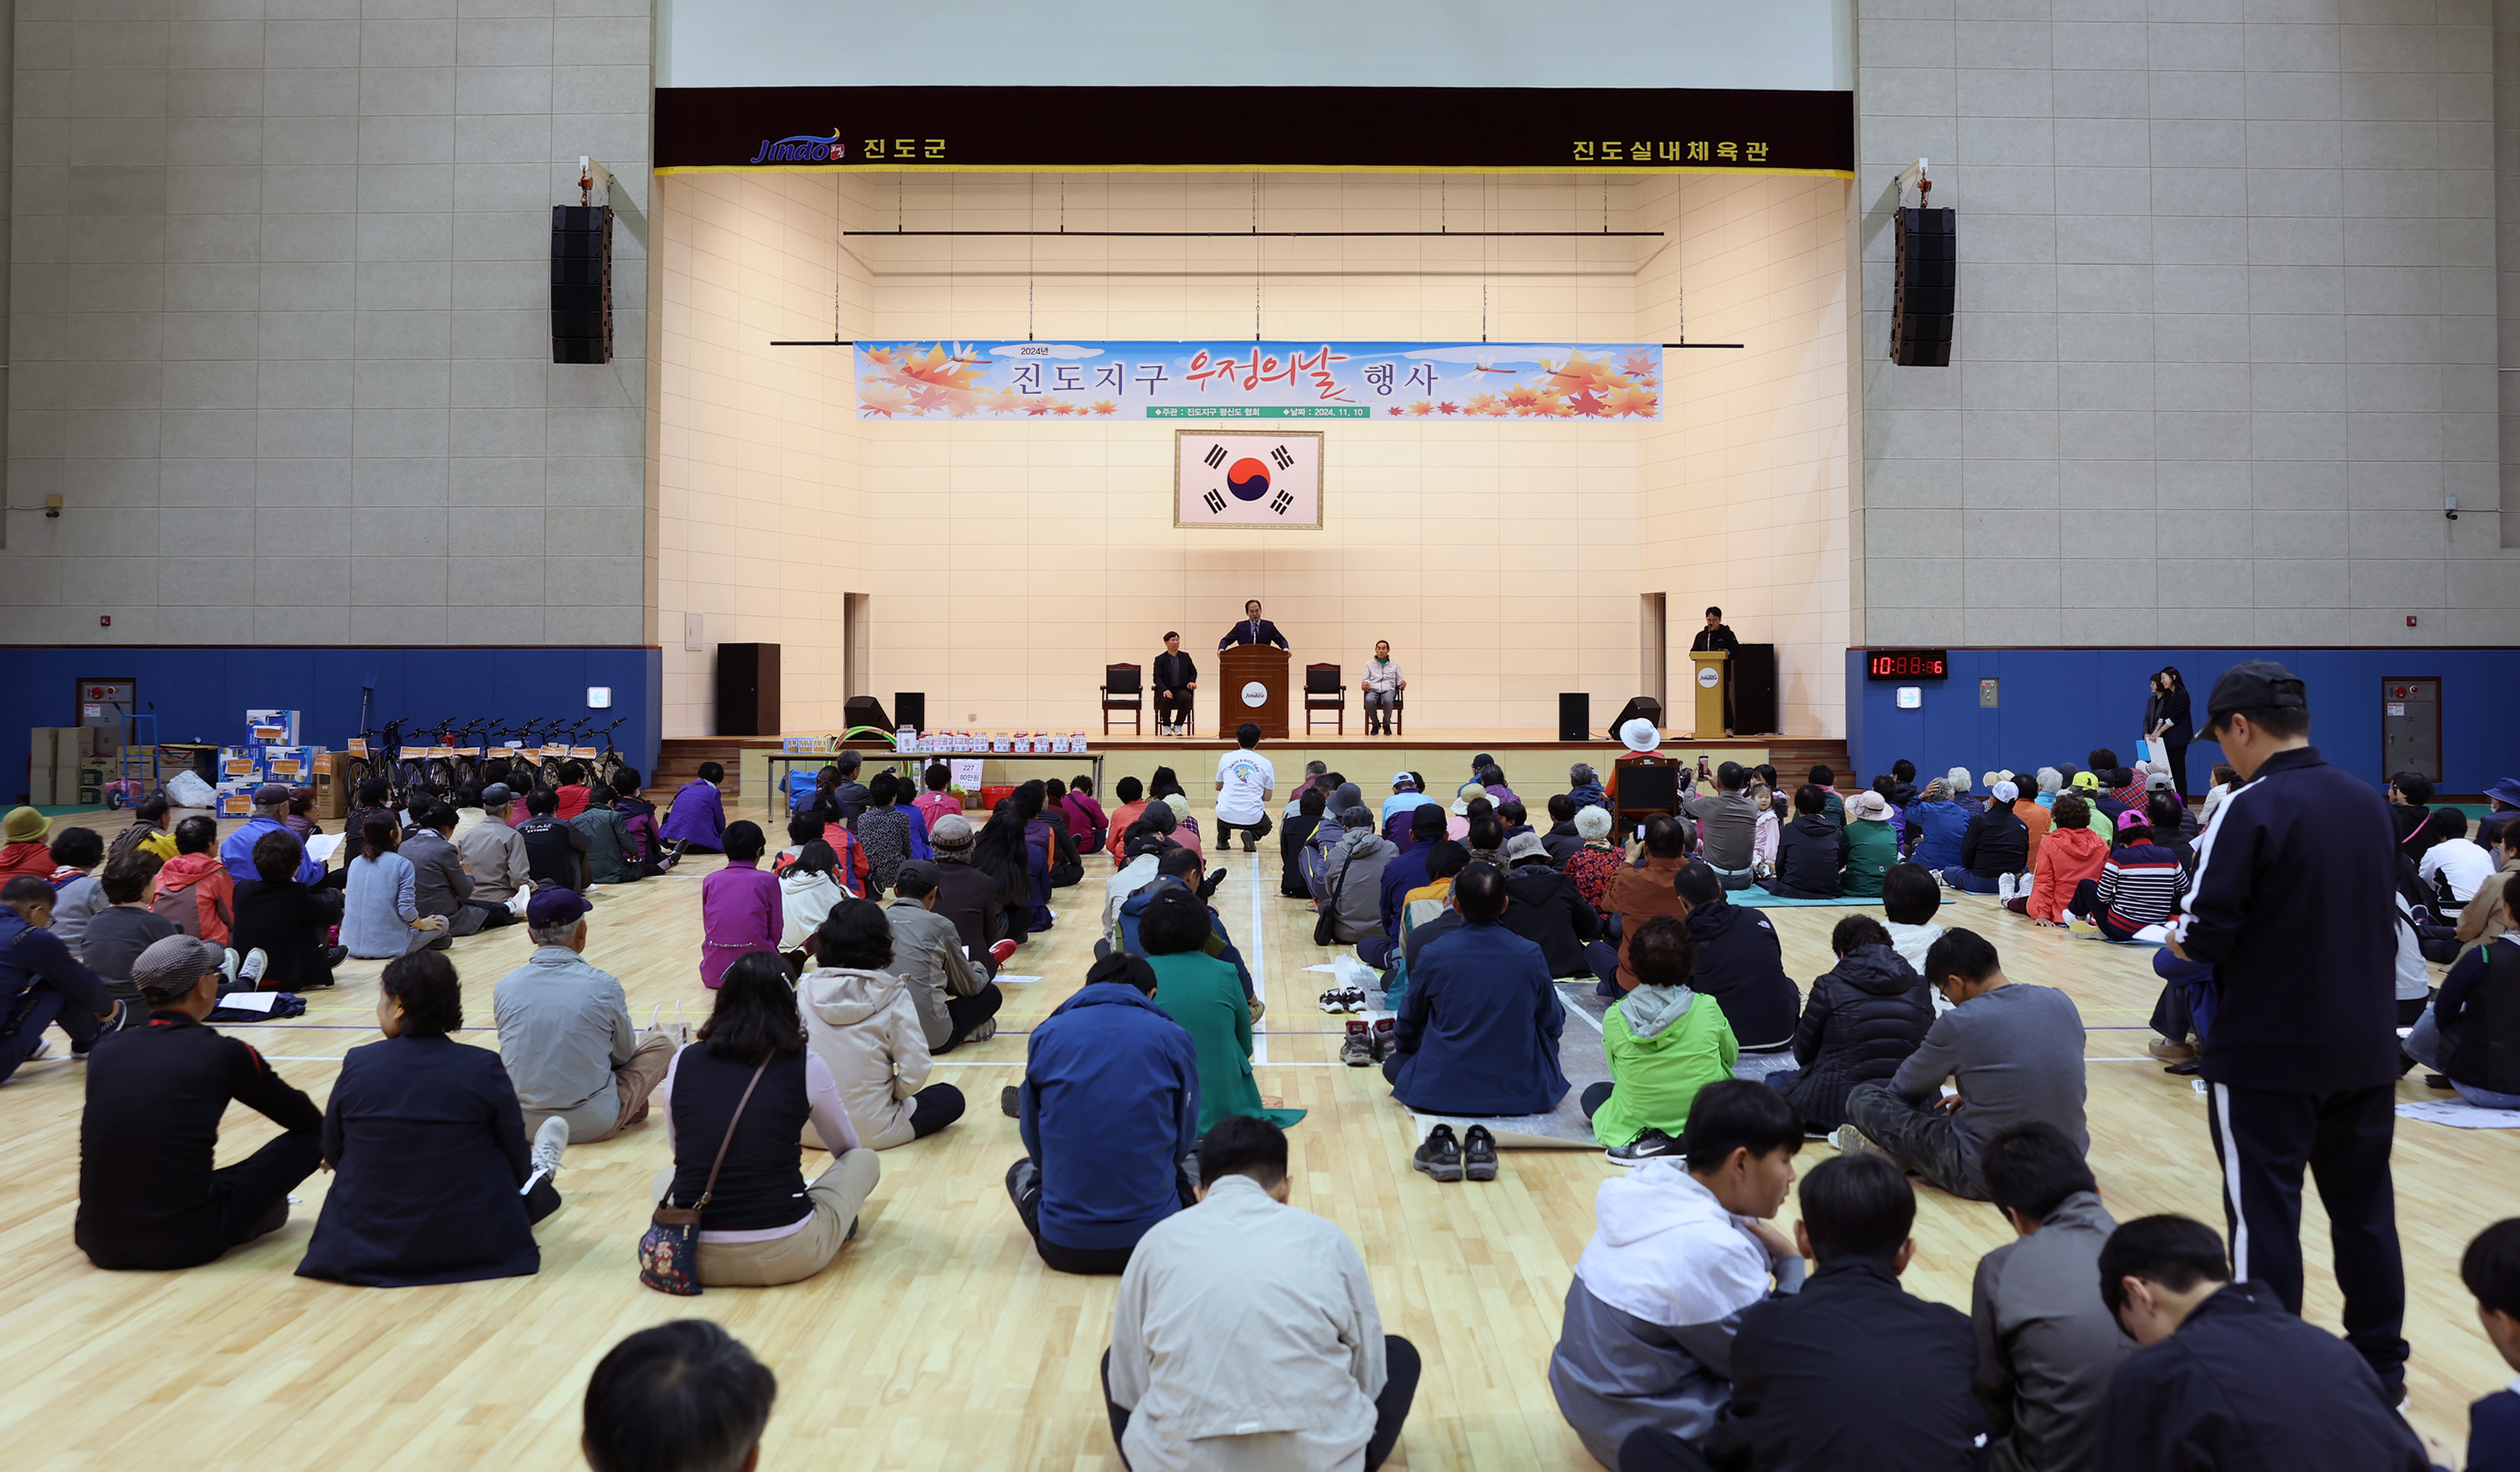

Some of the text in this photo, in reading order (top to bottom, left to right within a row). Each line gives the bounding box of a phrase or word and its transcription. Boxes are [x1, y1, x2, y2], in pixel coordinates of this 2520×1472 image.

[750, 139, 830, 163] Jindo
[863, 139, 945, 158] 진도군
[1573, 141, 1769, 162] 진도실내체육관
[1020, 347, 1048, 356] 2024년
[1012, 363, 1168, 395] 진도지구
[1364, 363, 1438, 396] 행사
[1187, 408, 1217, 416] 진도지구
[1220, 408, 1242, 416] 평신도
[1244, 408, 1260, 416] 협회
[1229, 759, 1239, 769] HAVE
